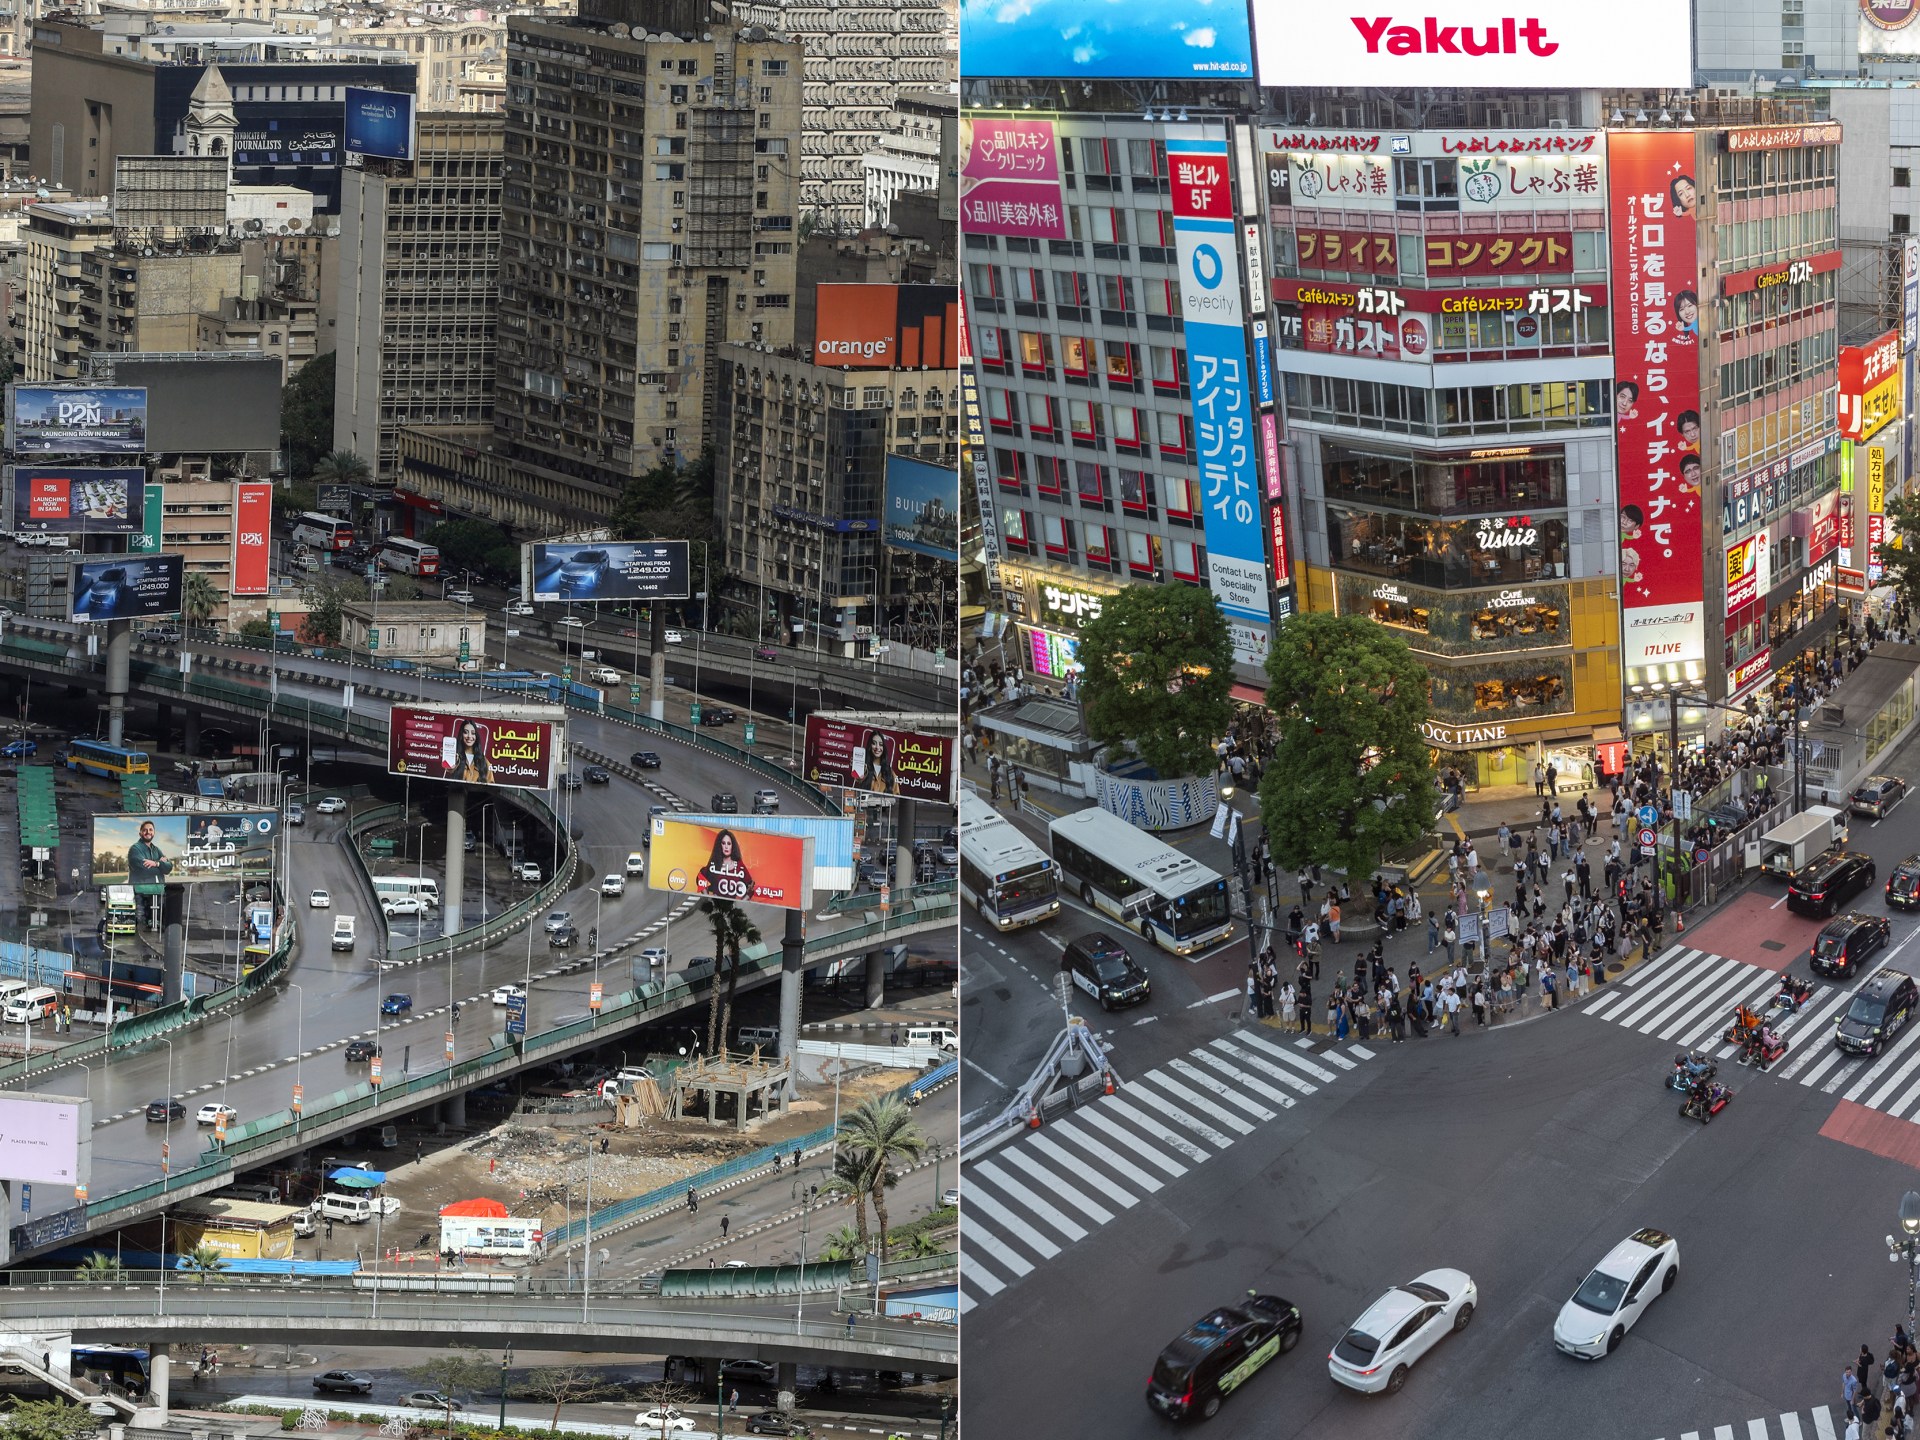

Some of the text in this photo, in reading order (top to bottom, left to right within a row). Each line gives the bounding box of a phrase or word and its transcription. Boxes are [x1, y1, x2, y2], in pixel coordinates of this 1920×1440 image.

[1864, 7, 1886, 29] EXCITING
[1350, 17, 1559, 57] Yakult
[1193, 62, 1247, 72] www.hit-ad.co.jp
[234, 140, 282, 152] JOURNALISTS
[994, 131, 1050, 151] 品川スキン
[1273, 132, 1382, 152] しゃぶしゃぶバイキング
[1441, 136, 1596, 153] しゃぶしゃぶバイキング
[997, 153, 1045, 172] クリニック
[1178, 162, 1220, 186] 当ビル
[1270, 169, 1288, 188] 9F
[1326, 164, 1388, 196] しゃぶ葉
[1510, 164, 1598, 194] しゃぶ葉
[1191, 190, 1212, 210] 5F
[973, 200, 1058, 228] 品川美容外科
[1300, 234, 1395, 266] プライス
[1428, 236, 1569, 266] コンタクト
[1250, 246, 1262, 302] 献血ルーム
[1789, 260, 1813, 286] ガスト
[1188, 295, 1234, 316] eyecity
[1358, 288, 1406, 315] ガスト
[1529, 288, 1592, 314] ガスト
[1280, 316, 1302, 336] 7F
[1308, 318, 1332, 332] Café
[1336, 316, 1394, 352] ガスト
[818, 337, 887, 360] orange
[1406, 334, 1425, 345] ガスト
[1864, 340, 1897, 385] スギ薬局
[1804, 410, 1811, 425] 5F
[1194, 354, 1231, 521] アイシティ
[1222, 357, 1253, 525] コンタクトの
[1828, 432, 1840, 451] 4F
[974, 453, 984, 461] 3F
[1266, 430, 1278, 485] 品川美容外科
[1872, 448, 1882, 494] 処方せん
[978, 478, 990, 496] 内科
[1270, 488, 1280, 496] 4F
[896, 497, 944, 518] BUILT TO
[1723, 492, 1760, 531] AGA
[1874, 495, 1880, 510] 3F
[895, 530, 914, 542] 16094
[1476, 527, 1537, 550] Ushi8
[1814, 517, 1834, 544] アコム
[1821, 544, 1828, 554] 3F
[1212, 562, 1263, 582] Contact Lens
[1729, 550, 1742, 582] 薬
[1220, 577, 1256, 594] Speciality
[1802, 560, 1832, 596] LUSH
[1229, 592, 1250, 604] Store
[1373, 589, 1408, 604] L'OCCITANE
[1488, 596, 1536, 610] L'OCCITANE
[1500, 590, 1522, 600] CAFÉ
[1728, 583, 1756, 608] サンドラッグ
[1645, 642, 1682, 656] 17LIVE
[492, 726, 540, 742] أسهل
[491, 743, 539, 762] أبلكيشن
[900, 739, 942, 757] أسهل
[488, 764, 539, 778] بيعمل كل حاجة
[898, 756, 942, 777] أبلكيشن
[894, 776, 941, 792] بيعمل كل حاجة
[669, 874, 686, 885] dmc
[762, 888, 783, 898] الحياة
